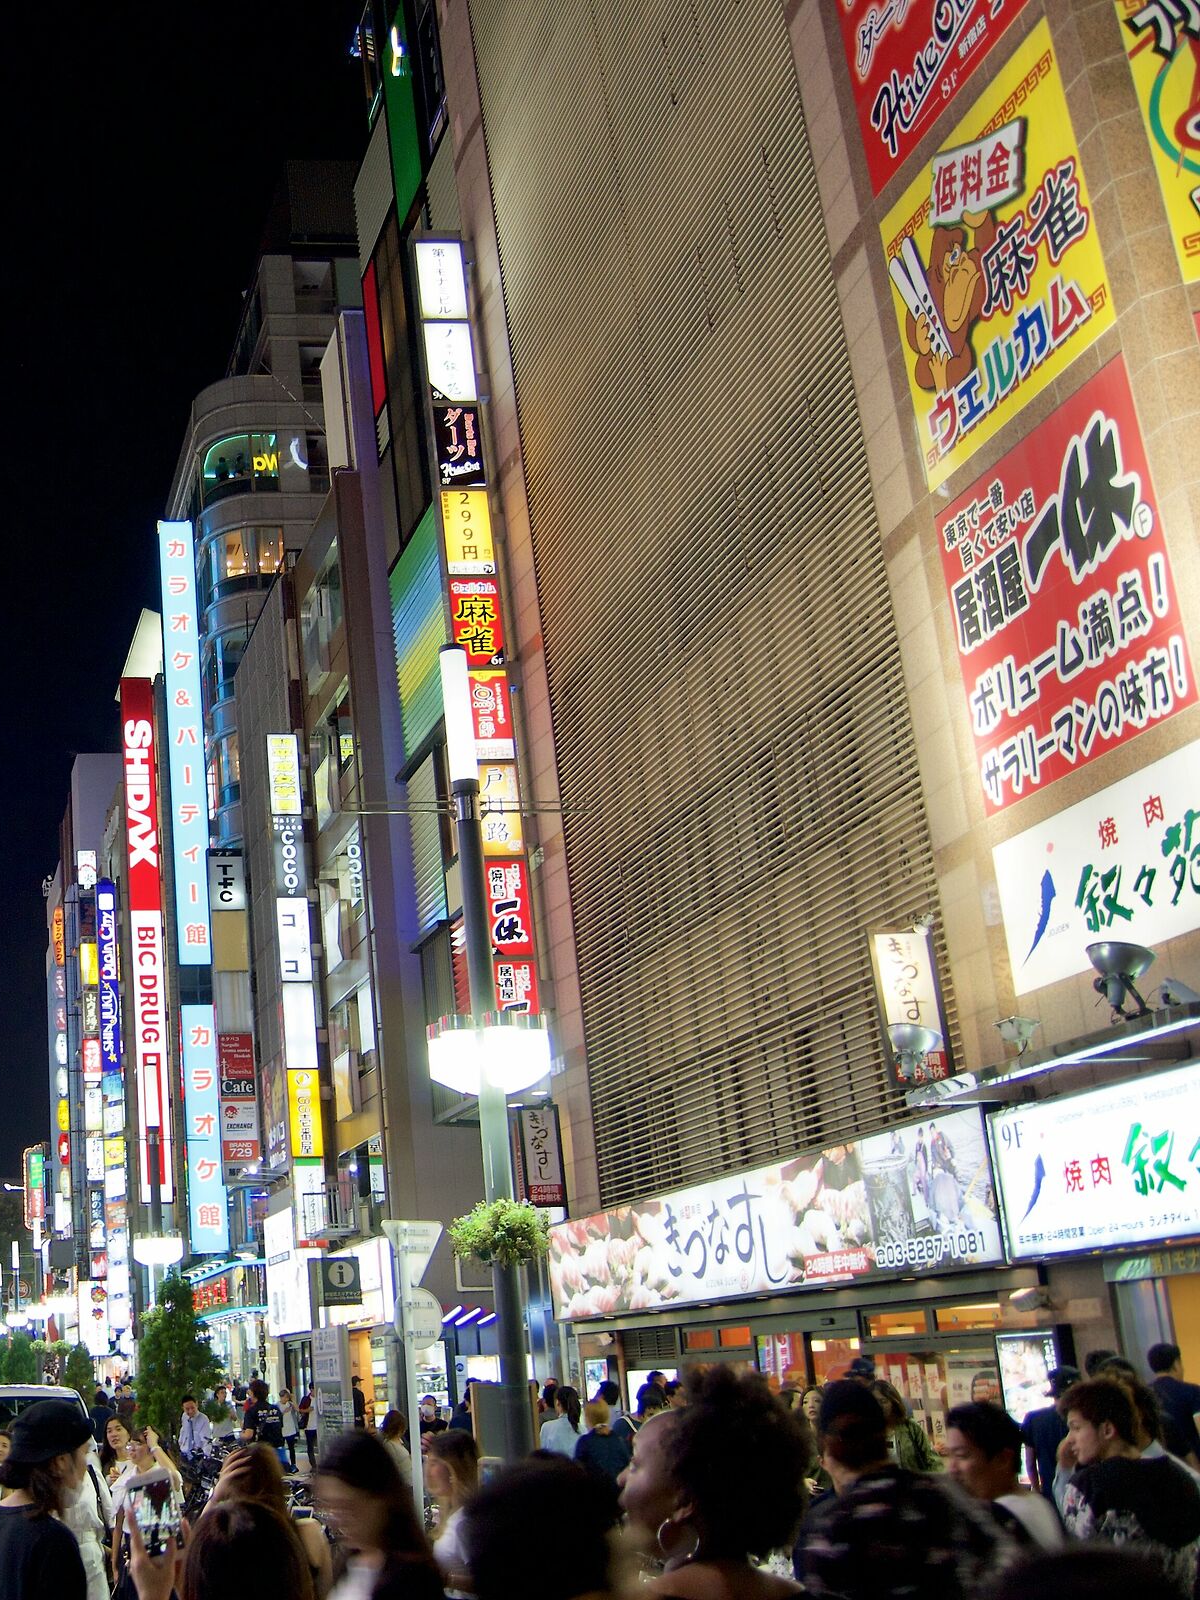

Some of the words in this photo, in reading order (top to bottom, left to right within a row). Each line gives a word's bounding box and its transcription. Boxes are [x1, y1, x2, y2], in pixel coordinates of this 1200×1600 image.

[941, 69, 959, 99] 8F
[934, 142, 1012, 217] 低料金
[981, 158, 1087, 318] 麻雀
[928, 277, 1091, 455] ウェルカム
[444, 408, 465, 461] ダーツ
[943, 480, 1004, 550] 東京で一番
[959, 490, 1035, 570] 旨くて安い店
[451, 582, 497, 594] ウェルカム
[952, 542, 1030, 652] 居酒屋
[455, 597, 497, 655] 麻雀
[491, 655, 503, 665] 6F
[124, 719, 158, 868] SHIDAX
[138, 927, 157, 966] BIC
[139, 975, 160, 1043] DRUG
[500, 966, 513, 1000] 居酒屋
[221, 1079, 254, 1093] Cafe
[192, 1026, 222, 1227] カラオケ館
[229, 1148, 253, 1158] 729
[1001, 1120, 1024, 1150] 9F
[1064, 1153, 1112, 1193] 焼肉
